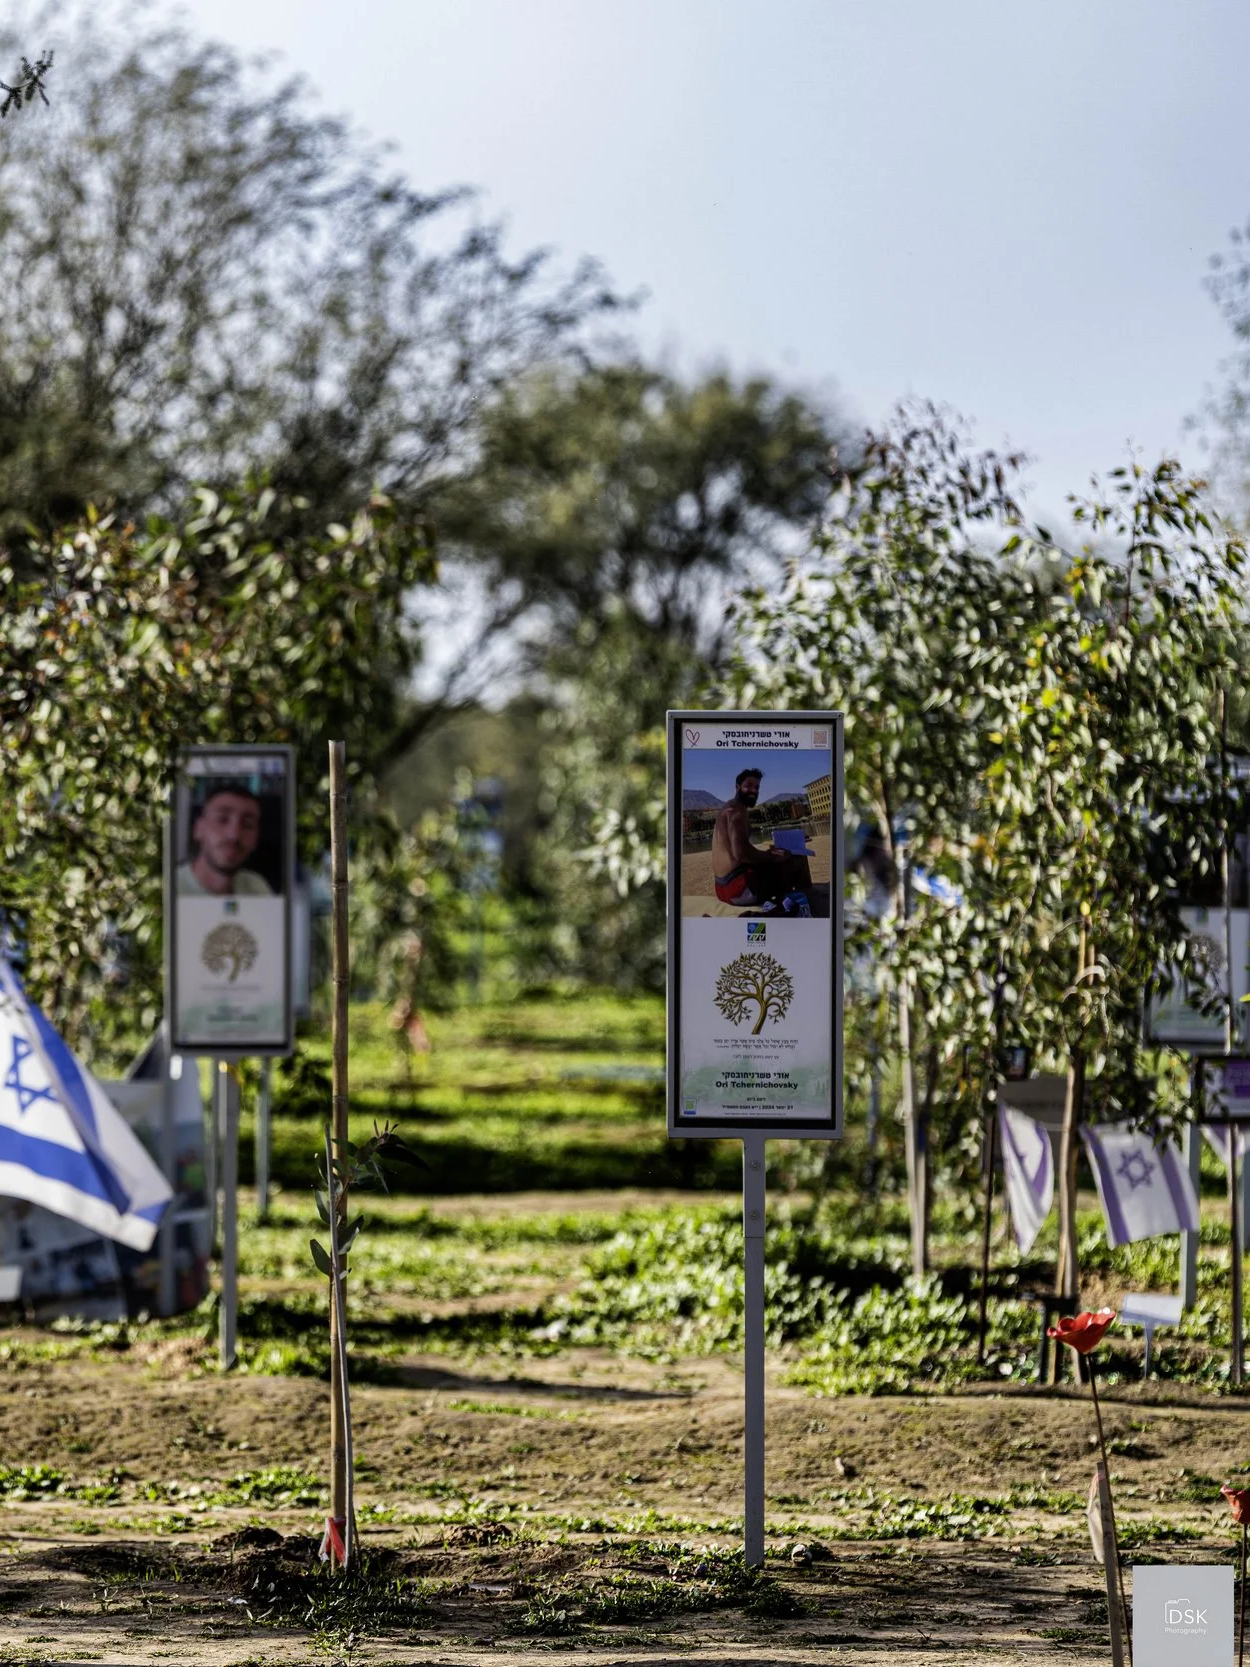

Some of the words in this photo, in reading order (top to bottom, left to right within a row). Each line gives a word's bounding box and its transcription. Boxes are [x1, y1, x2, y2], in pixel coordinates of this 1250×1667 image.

[722, 731, 772, 739] טשרניחובסקי
[731, 740, 799, 748] Tchernichovsky
[721, 1072, 771, 1080] טשרניחובסקי
[731, 1081, 799, 1090] Tchernichovsky
